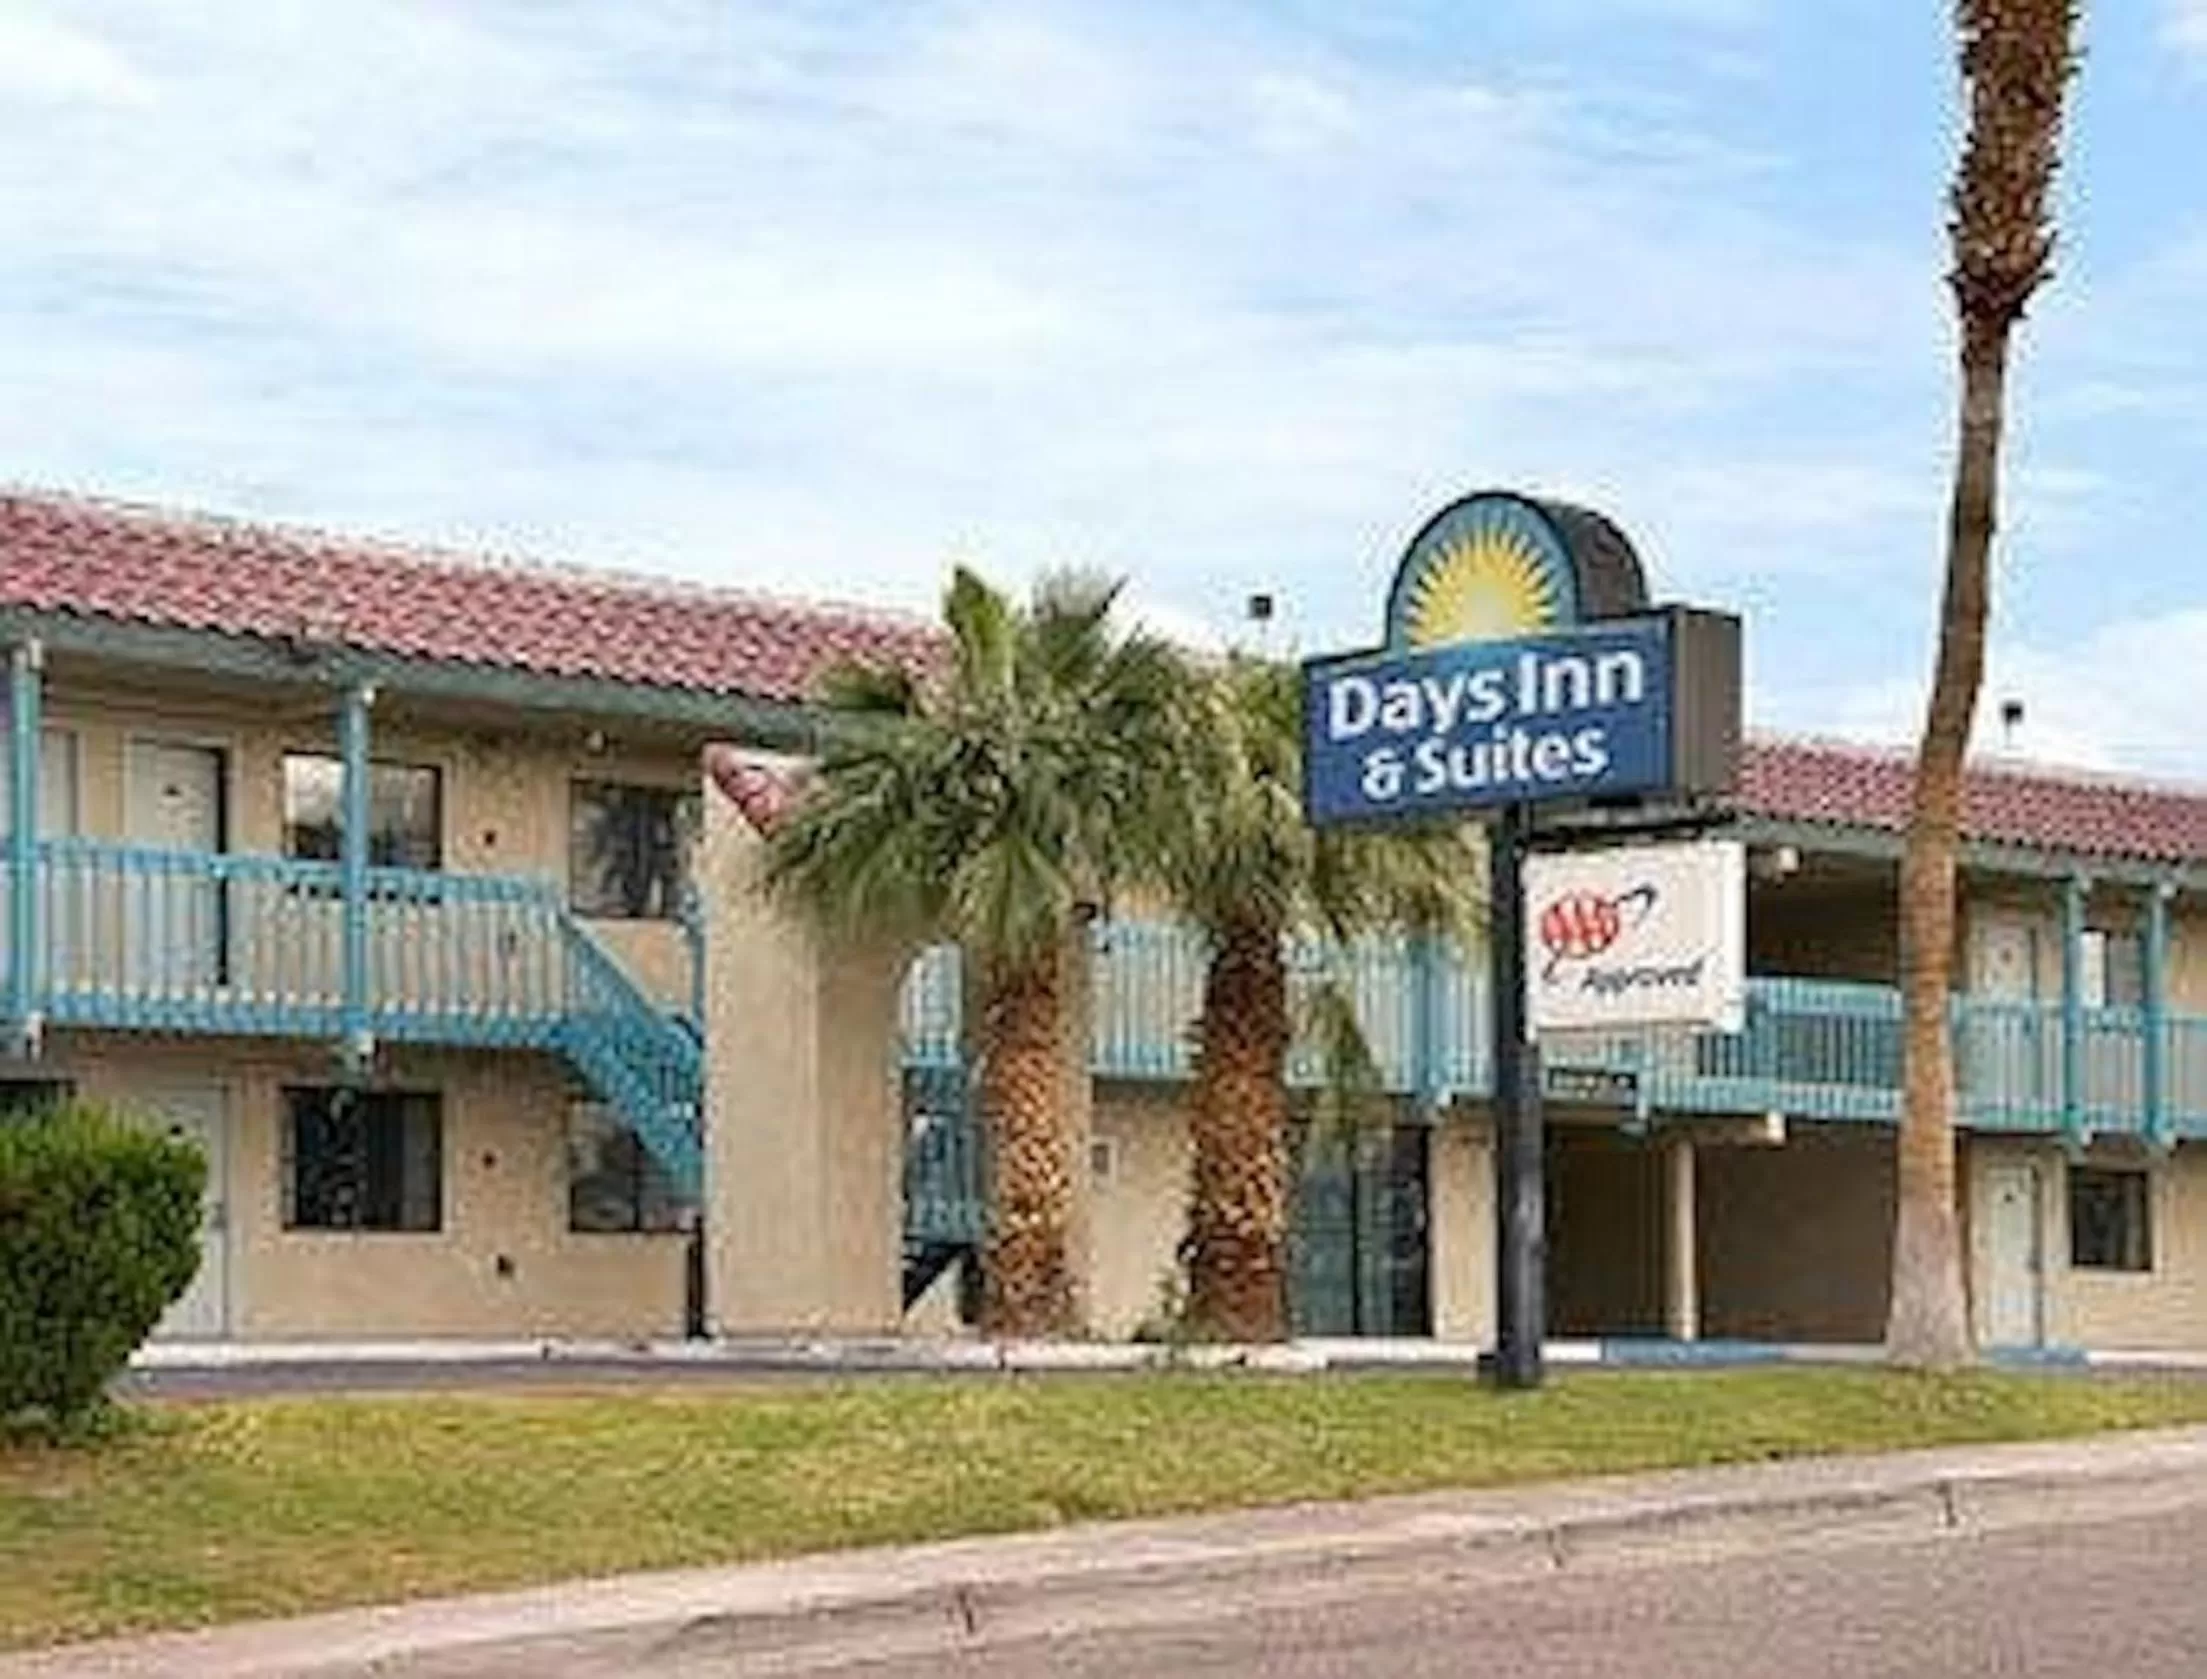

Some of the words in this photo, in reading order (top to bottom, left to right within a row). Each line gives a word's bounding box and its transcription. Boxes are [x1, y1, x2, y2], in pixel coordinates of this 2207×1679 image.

[1329, 666, 1507, 740] Days
[1518, 651, 1644, 714] Inn
[1362, 747, 1406, 800] &
[1415, 726, 1609, 794] Suites
